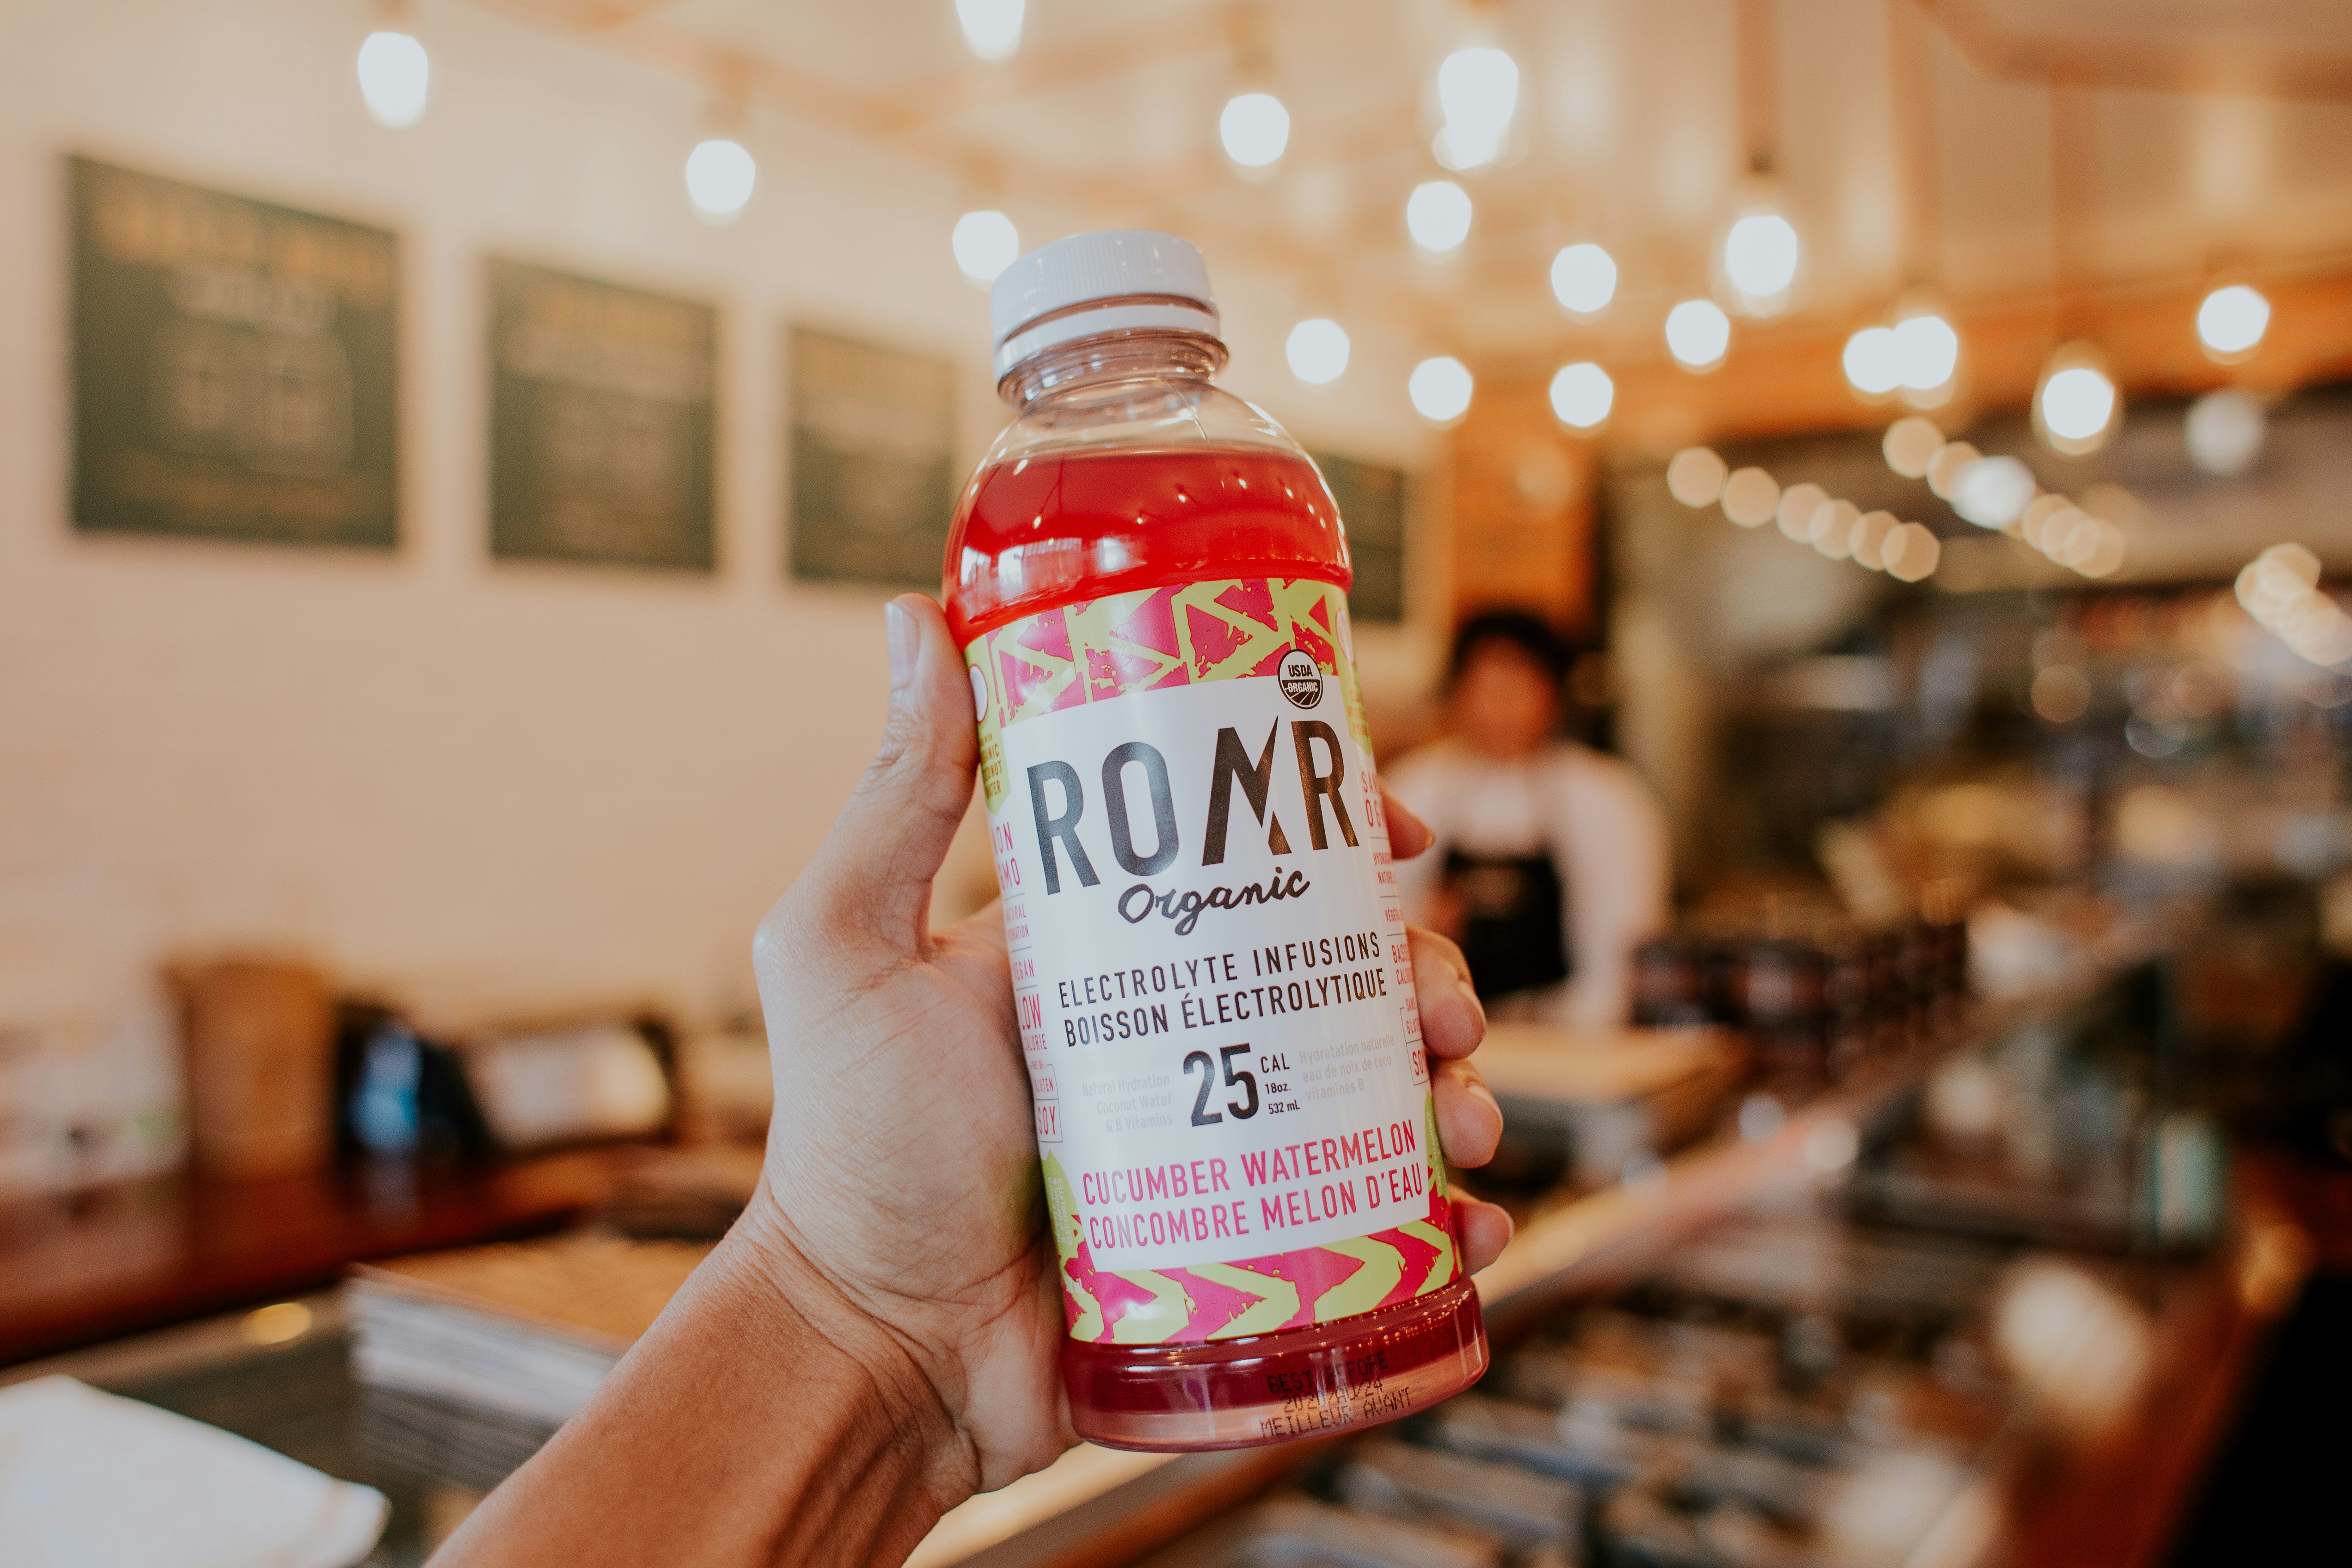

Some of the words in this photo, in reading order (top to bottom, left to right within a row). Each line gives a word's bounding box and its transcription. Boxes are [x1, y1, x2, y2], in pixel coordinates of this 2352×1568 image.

[1288, 665, 1313, 677] USDA
[1287, 682, 1318, 693] ORGANIC
[980, 743, 999, 764] ANIC
[983, 760, 1002, 781] ONUT
[986, 780, 1001, 798] ATER
[1365, 798, 1384, 828] OG
[1006, 903, 1026, 922] ATURAL
[1118, 866, 1310, 936] Organic
[1008, 924, 1029, 942] RATION
[1058, 953, 1238, 1008] ELECTROLYTE
[1253, 931, 1380, 976] INFUSIONS
[1018, 993, 1042, 1030] LOW
[1064, 1004, 1169, 1047] BOISSON
[1181, 968, 1387, 1029] ÉLECTROLYTIQUE
[1299, 1042, 1360, 1065] Hydratation
[1361, 1034, 1395, 1052] naturelle
[1260, 1053, 1290, 1073] CAL
[1303, 1069, 1322, 1082] eau
[1325, 1064, 1337, 1078] de
[1340, 1060, 1360, 1076] noix
[1362, 1057, 1372, 1071] de
[1374, 1056, 1392, 1069] coco
[1034, 1078, 1054, 1092] LUTEN
[1082, 1081, 1115, 1097] Natural
[1118, 1074, 1170, 1094] Hydration
[1183, 1042, 1259, 1127] 25
[1265, 1082, 1291, 1094] 18oz.
[1305, 1082, 1356, 1101] vitamines
[1357, 1078, 1365, 1091] B
[1097, 1097, 1136, 1114] Coconut
[1139, 1093, 1172, 1109] Water
[1268, 1102, 1284, 1114] 532
[1287, 1099, 1300, 1112] mL
[1037, 1106, 1055, 1135] SOY
[1106, 1119, 1113, 1132] &
[1115, 1118, 1122, 1132] B
[1125, 1112, 1173, 1130] Vitamins
[1083, 1158, 1231, 1205] CUCUMBER
[1240, 1119, 1416, 1186] WATERMELON
[1090, 1200, 1250, 1249] CONCOMBRE
[1261, 1179, 1357, 1230] MELON
[1366, 1162, 1423, 1209] D'EAU
[1267, 1369, 1313, 1393] BEST
[1325, 1350, 1388, 1384] BEFORE
[1259, 1405, 1354, 1437] MEILLEUR
[1363, 1386, 1410, 1418] AVANT
